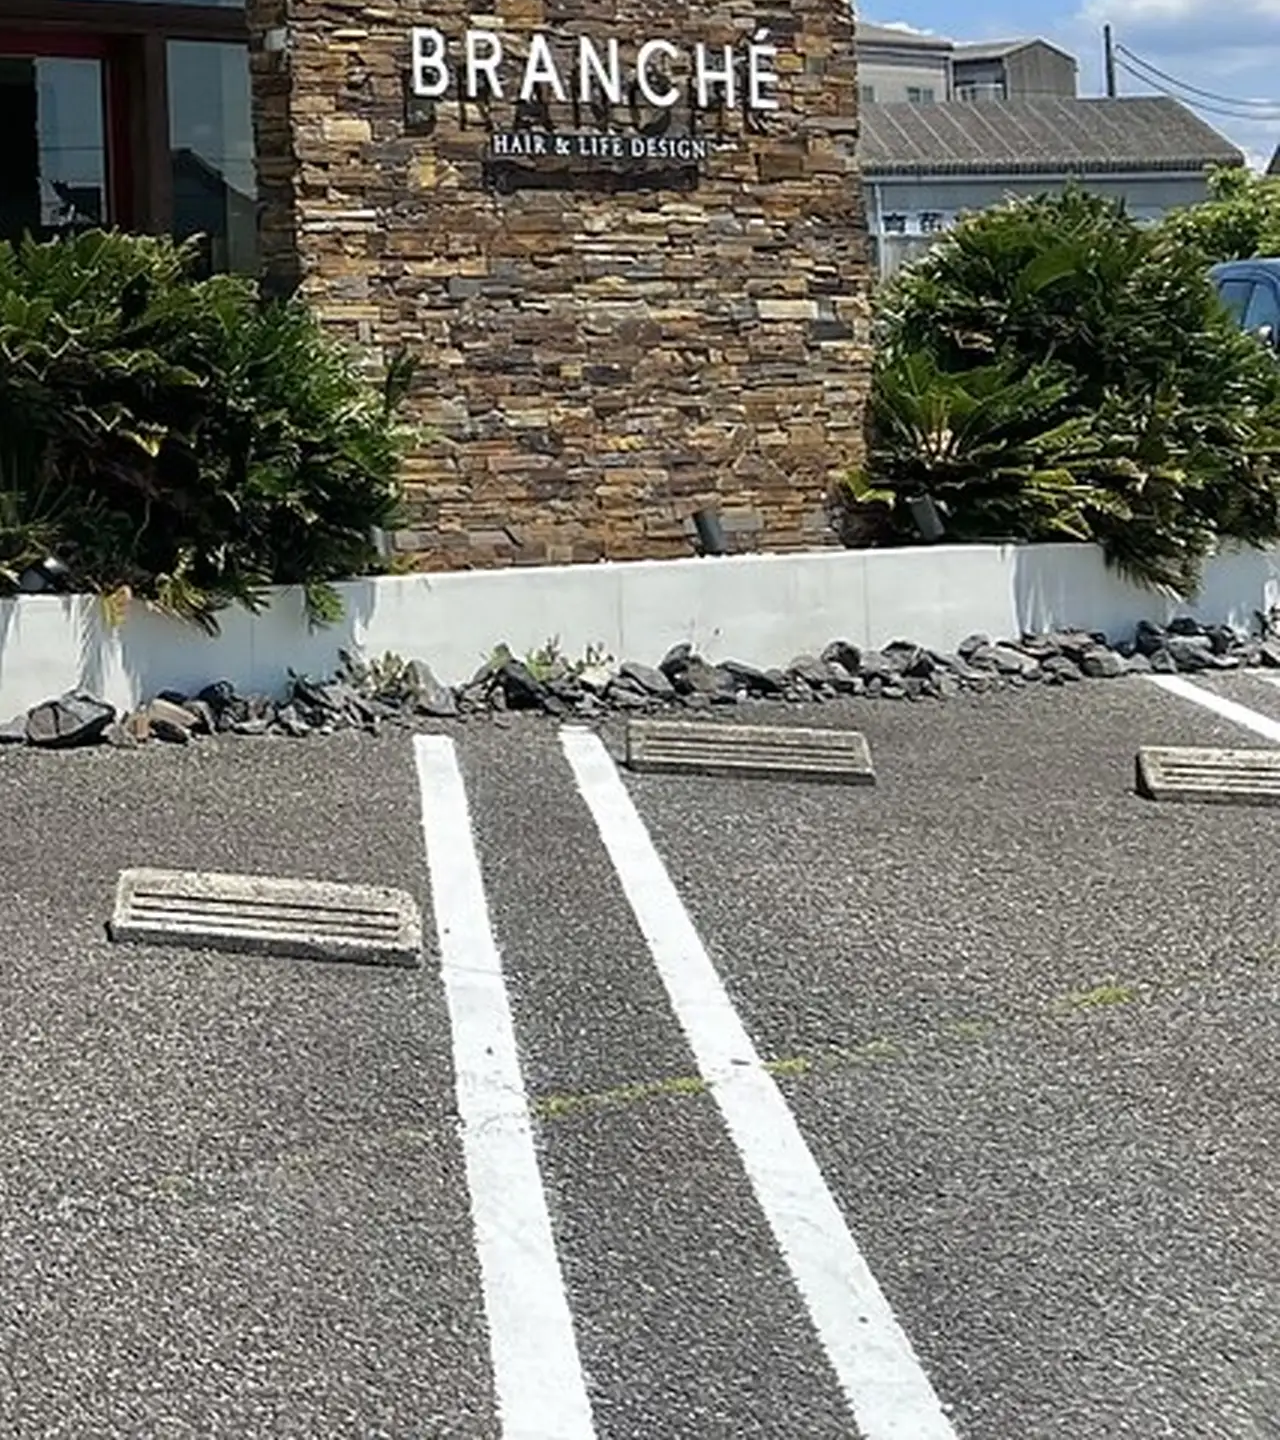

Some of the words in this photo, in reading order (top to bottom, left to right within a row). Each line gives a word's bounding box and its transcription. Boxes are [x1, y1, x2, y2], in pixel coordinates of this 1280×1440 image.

[411, 26, 780, 110] BRANCHÉ
[493, 134, 547, 155] HAIR
[555, 137, 570, 156] &
[578, 136, 624, 157] LIFE
[631, 137, 706, 159] DESIGN
